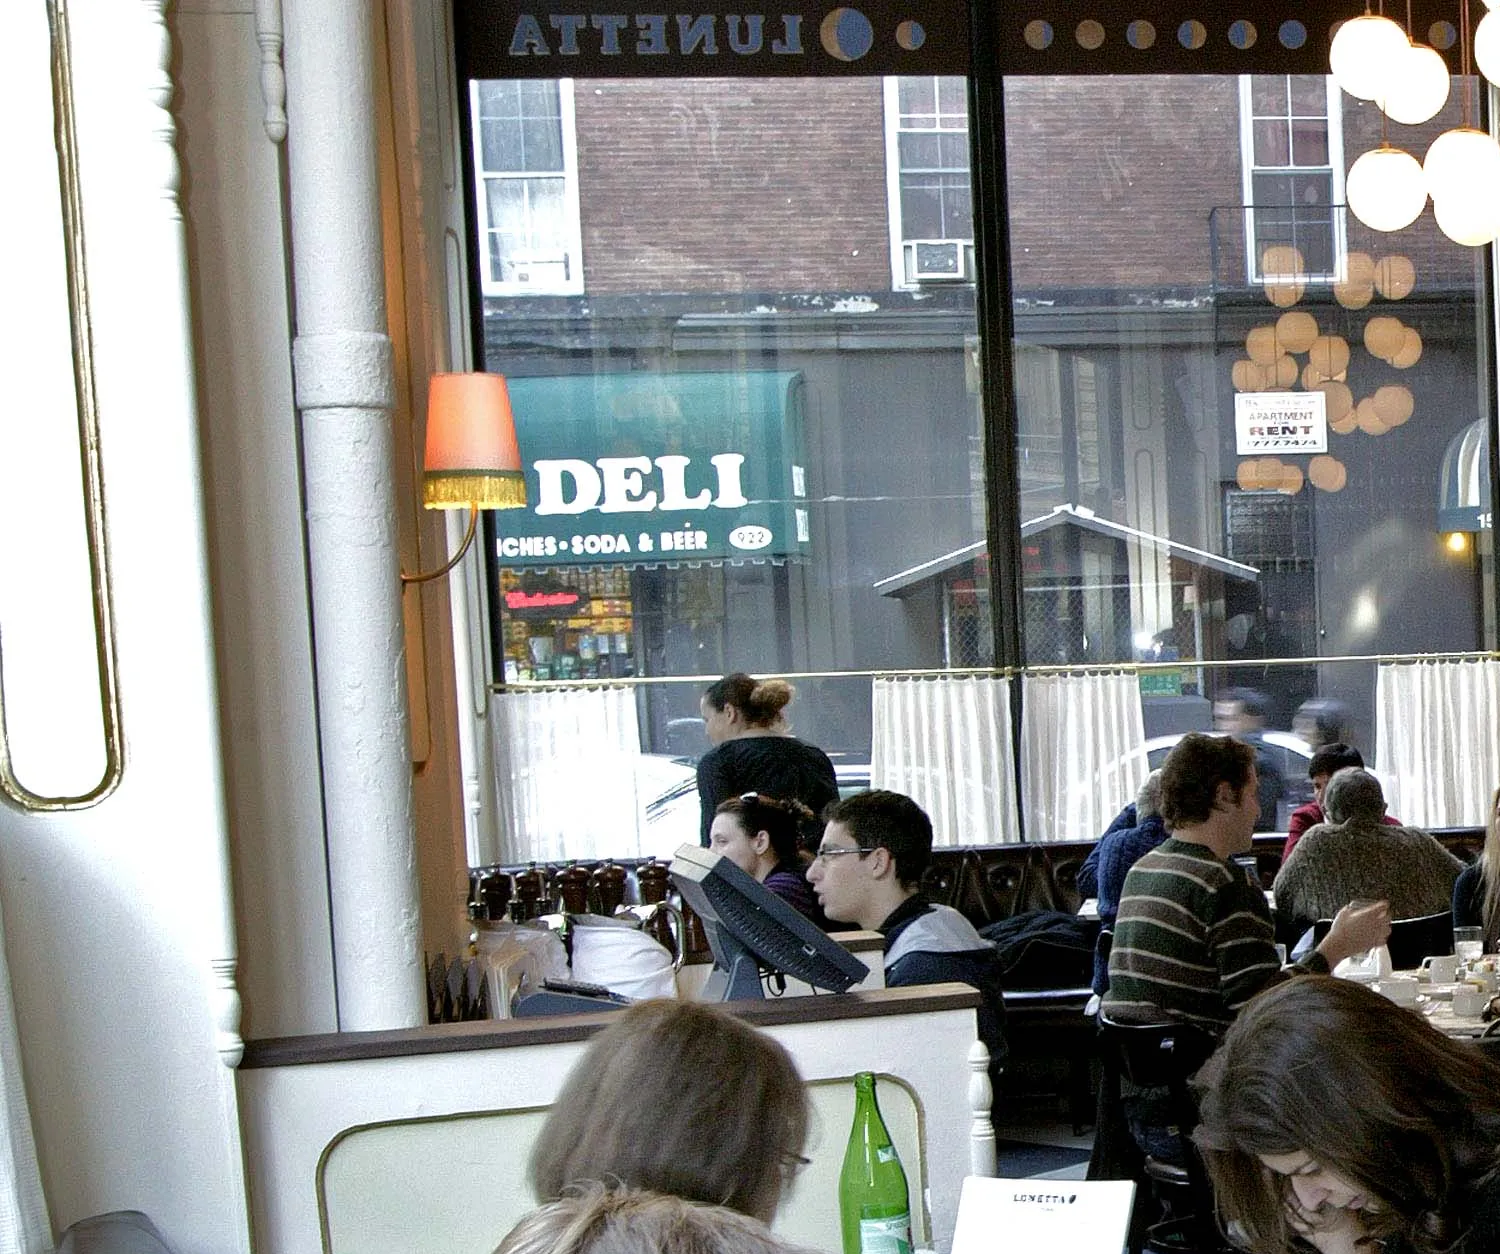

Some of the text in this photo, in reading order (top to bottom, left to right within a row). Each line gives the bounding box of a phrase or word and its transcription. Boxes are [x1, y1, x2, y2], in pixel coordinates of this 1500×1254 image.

[1249, 425, 1314, 436] RENT
[533, 453, 748, 515] DELI
[571, 533, 630, 555] SODA
[638, 532, 653, 552] &
[660, 530, 708, 552] BEER
